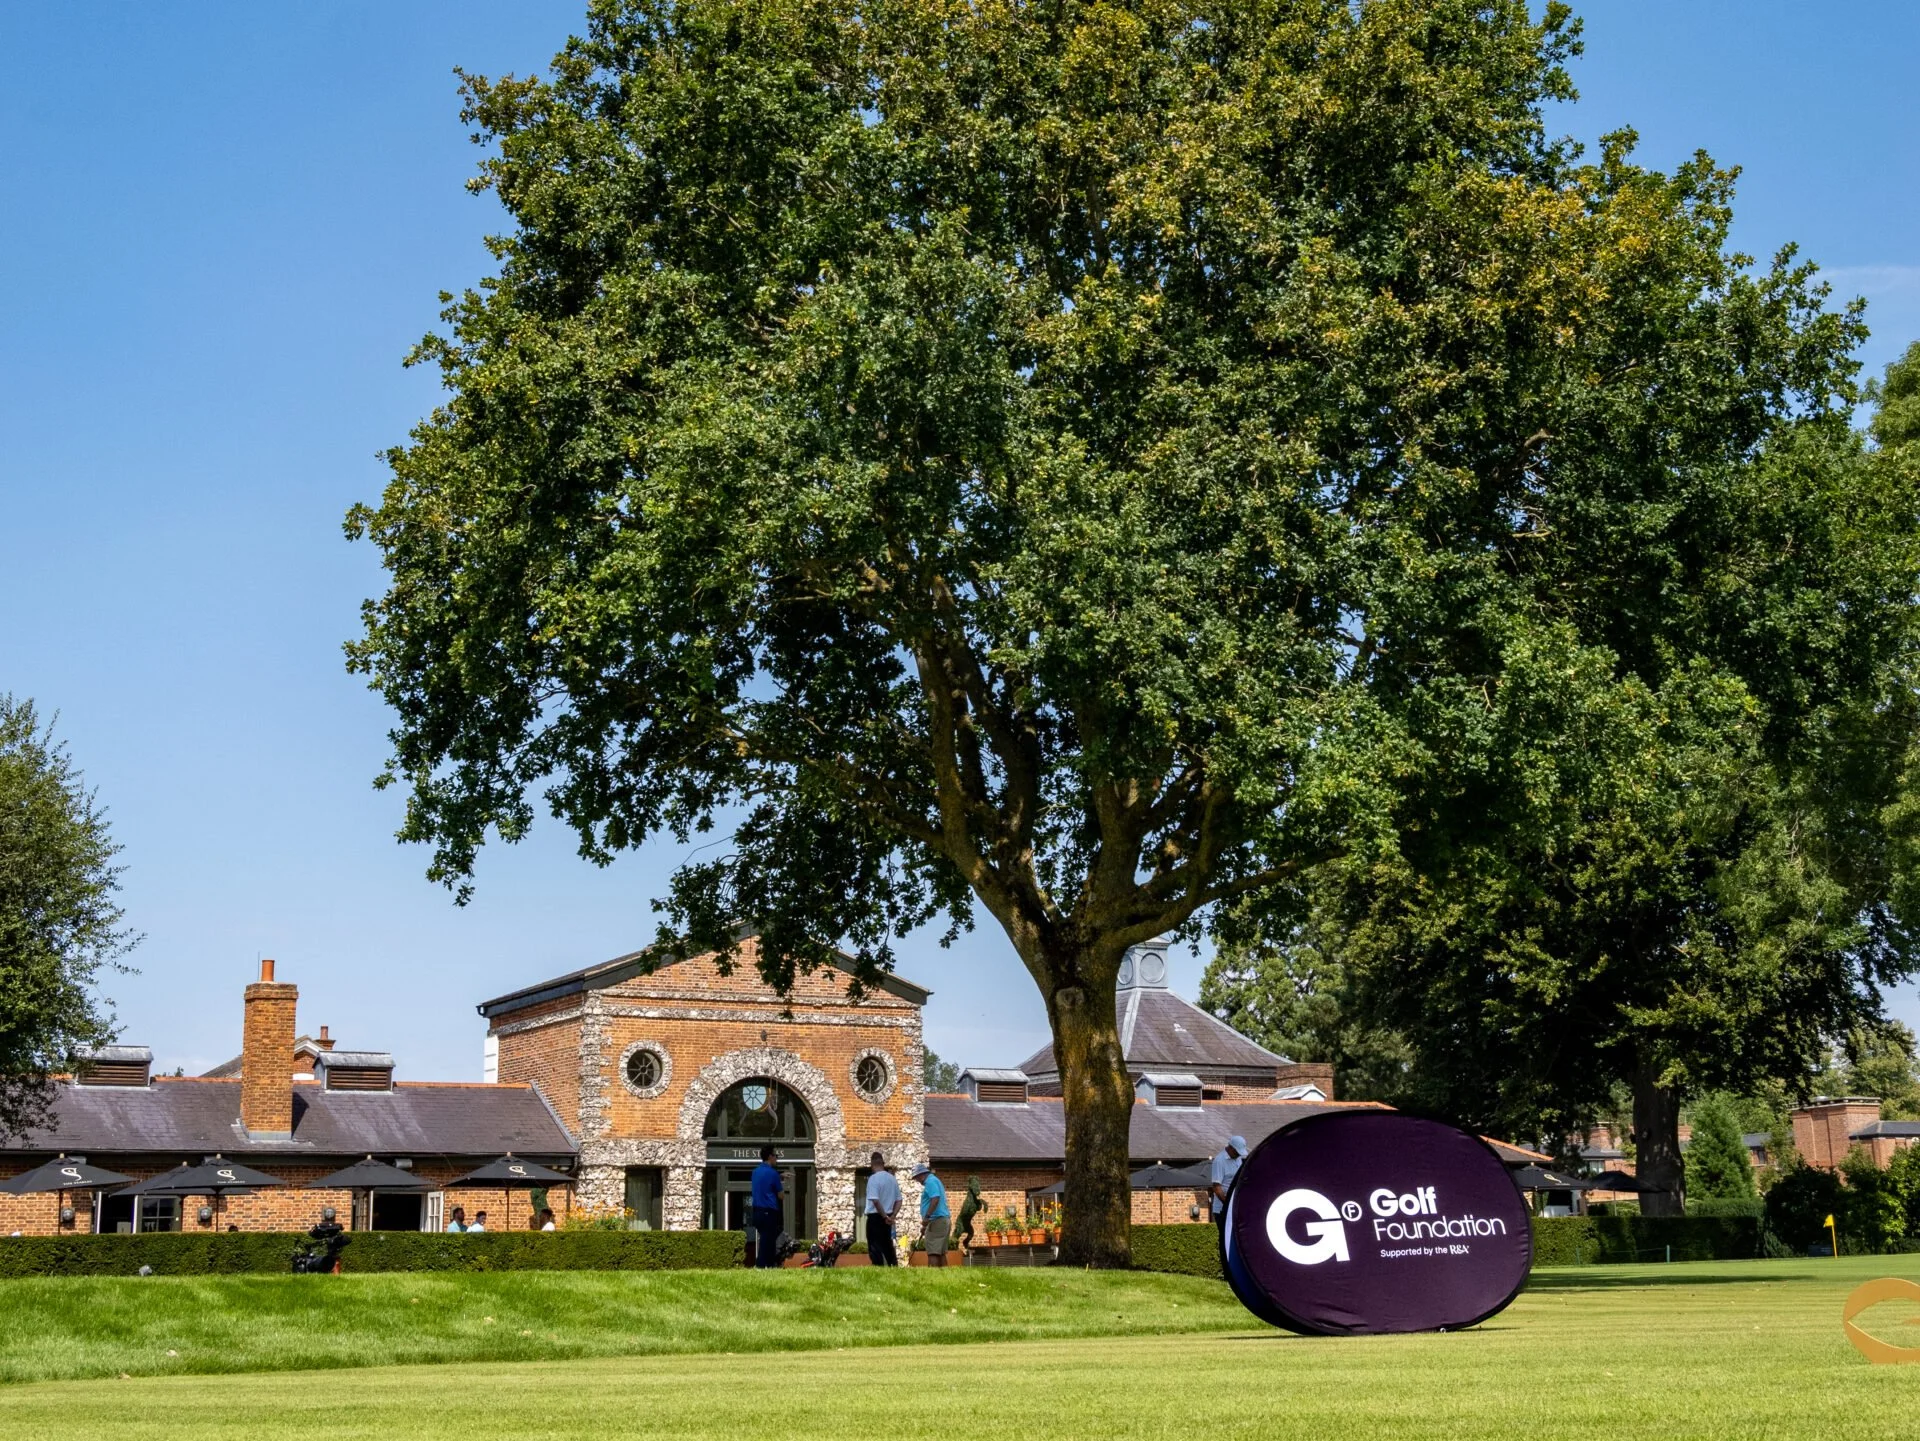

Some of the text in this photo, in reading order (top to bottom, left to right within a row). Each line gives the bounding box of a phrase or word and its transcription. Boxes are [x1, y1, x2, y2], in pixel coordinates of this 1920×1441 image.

[732, 1149, 750, 1158] THE
[1369, 1186, 1438, 1217] Golf
[1373, 1214, 1507, 1241] Foundation
[1380, 1247, 1422, 1258] Supported
[1423, 1247, 1433, 1256] by
[1434, 1246, 1448, 1254] the
